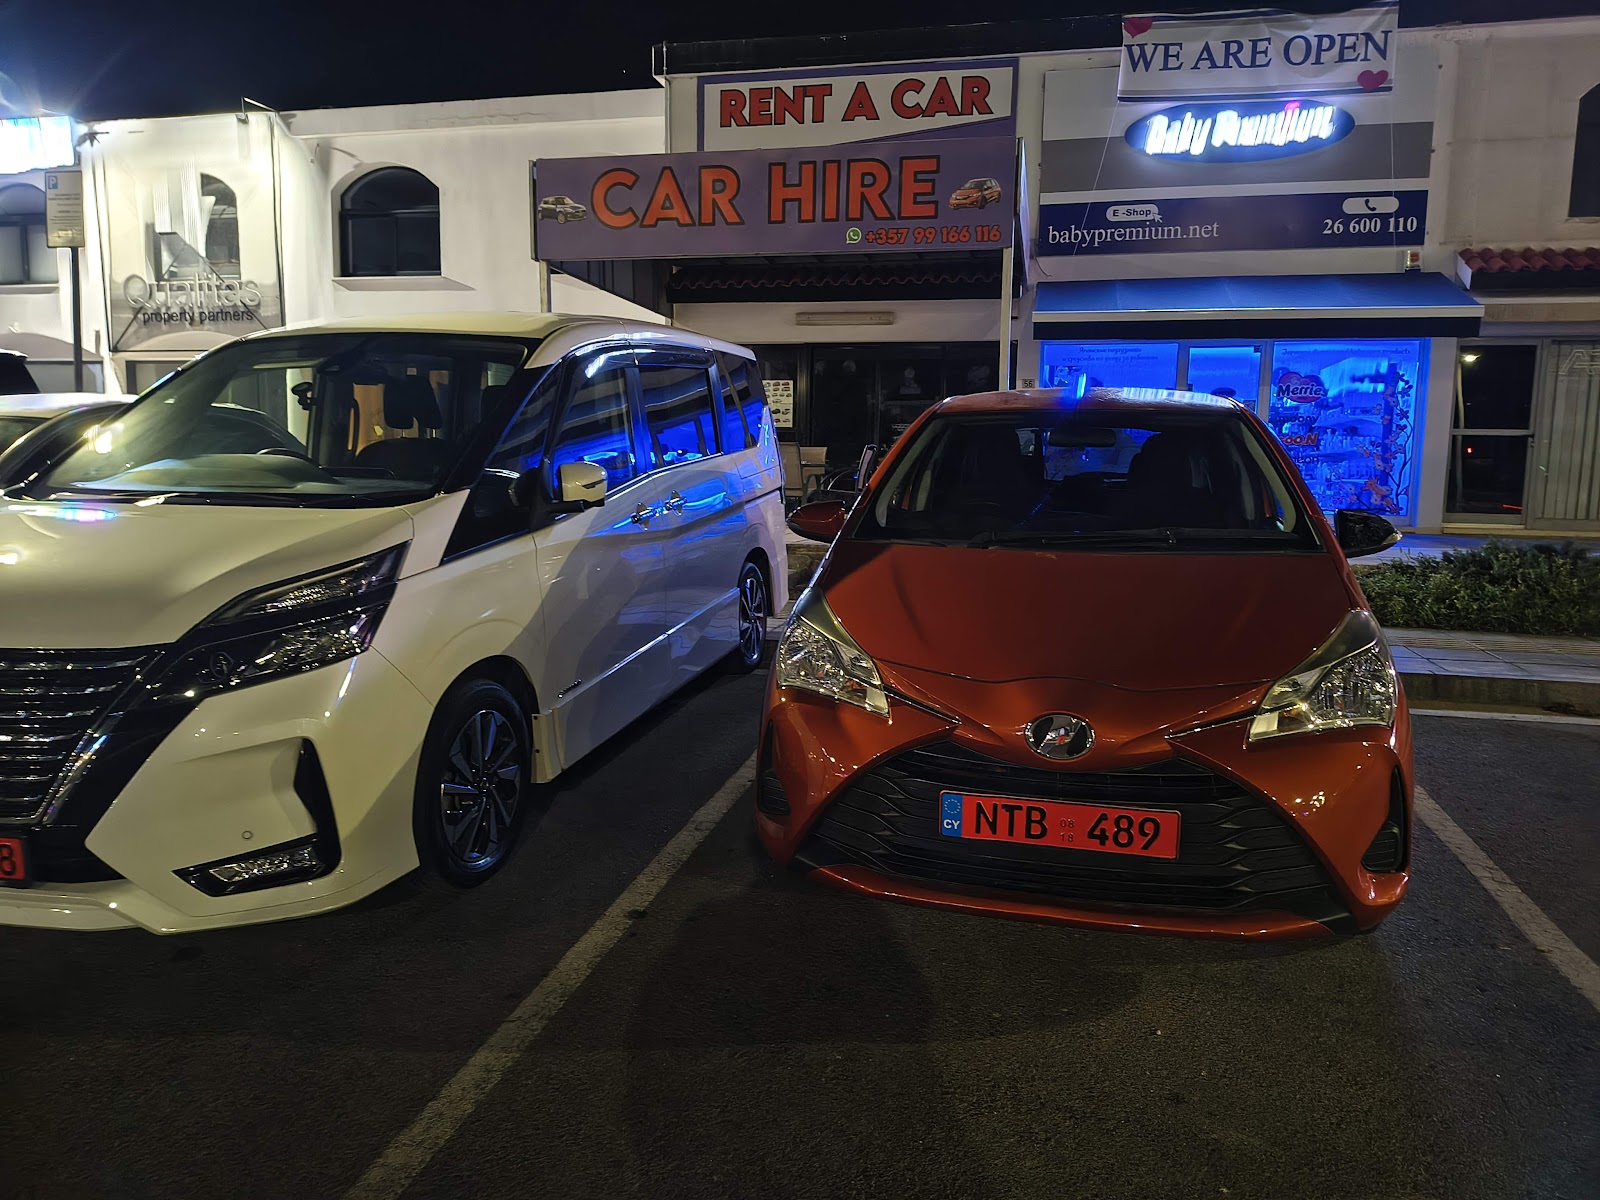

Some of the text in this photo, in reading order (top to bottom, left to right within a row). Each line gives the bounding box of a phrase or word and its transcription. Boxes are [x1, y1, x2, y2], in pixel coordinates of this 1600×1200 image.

[1124, 30, 1393, 73] WE ARE OPEN
[719, 75, 994, 128] RENT A CAR
[590, 155, 941, 231] CAR HIRE
[865, 225, 1001, 246] +357 99 166 116
[1047, 221, 1220, 248] babypremium.net
[1322, 216, 1418, 235] 26 600 110
[123, 272, 263, 309] Qualitas
[142, 308, 255, 326] property partners
[1023, 380, 1034, 388] 56
[1277, 384, 1328, 397] Merries
[943, 800, 1161, 851] CY NTB 08 489
[1060, 832, 1074, 843] 18
